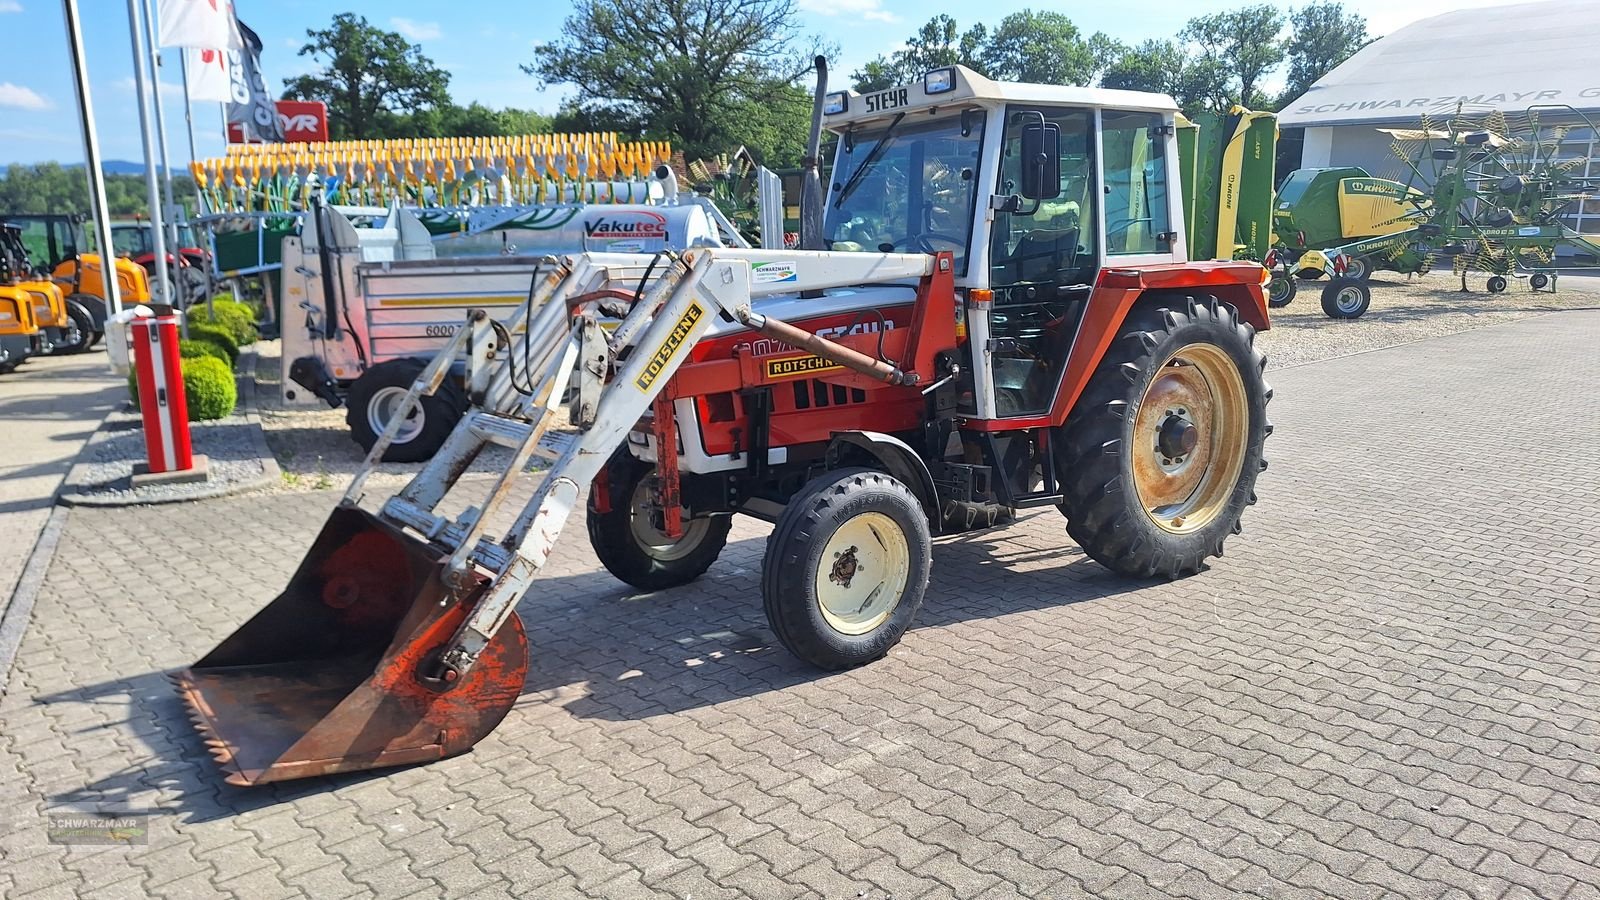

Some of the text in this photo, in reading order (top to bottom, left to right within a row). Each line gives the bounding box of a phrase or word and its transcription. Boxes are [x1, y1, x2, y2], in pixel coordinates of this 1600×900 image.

[865, 88, 909, 113] STEYR
[1295, 89, 1562, 115] SCHWARZMAYR
[584, 217, 665, 237] Vakutec
[640, 306, 700, 386] ROTSCHNE
[773, 356, 838, 374] ROTSCHN
